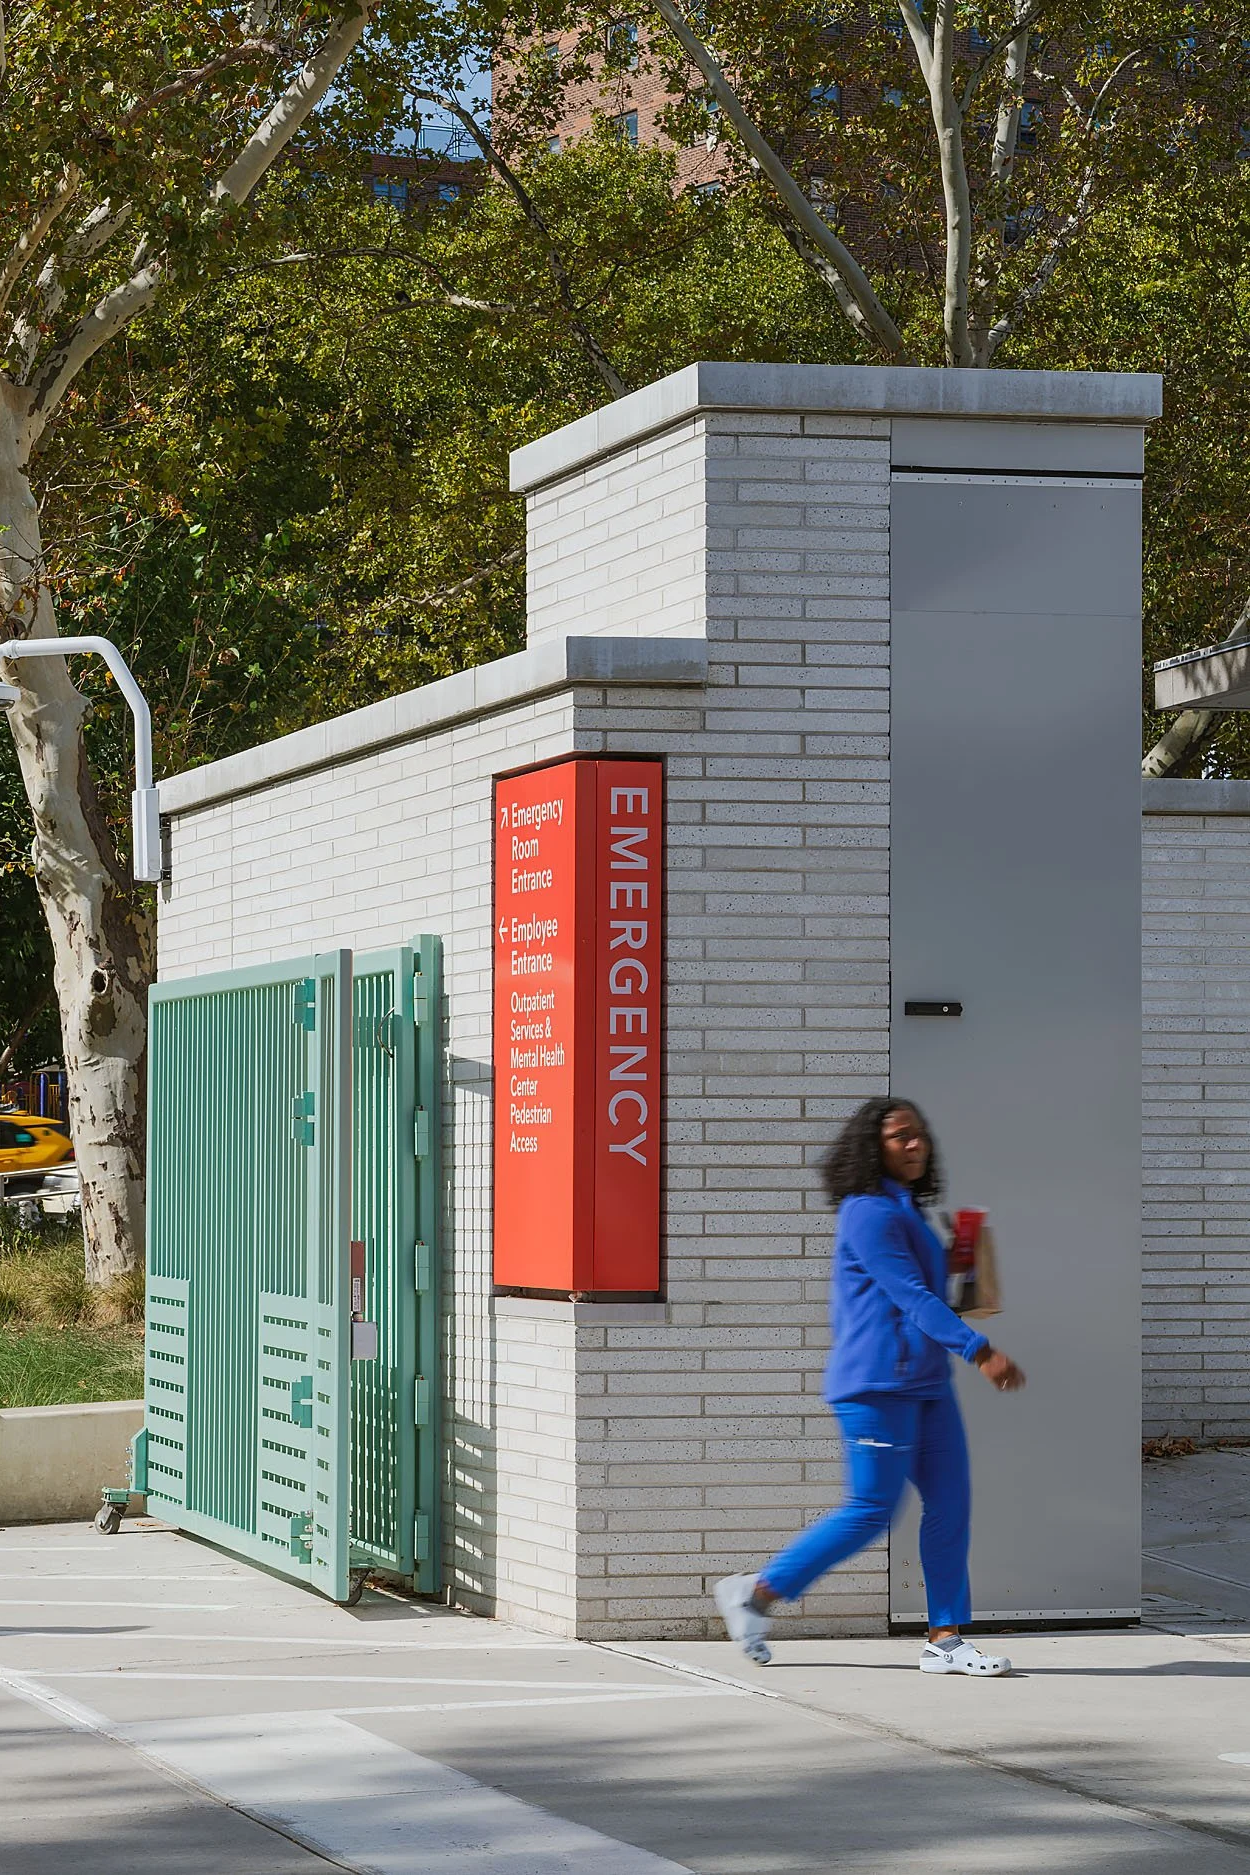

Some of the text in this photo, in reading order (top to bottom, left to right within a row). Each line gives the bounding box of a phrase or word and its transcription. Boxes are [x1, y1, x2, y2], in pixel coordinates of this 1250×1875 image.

[511, 799, 564, 831] Emergency
[511, 835, 539, 861] Room
[511, 867, 553, 894] Entrance
[511, 913, 559, 948] Employee
[511, 950, 553, 976] Entrance
[608, 787, 649, 1167] EMERGENCY
[510, 988, 555, 1018] Outpatient
[510, 1016, 552, 1041] Services &
[510, 1042, 565, 1069] Mental Health
[510, 1074, 538, 1097] Center
[510, 1101, 552, 1125] Pedestrian
[509, 1131, 538, 1153] Access
